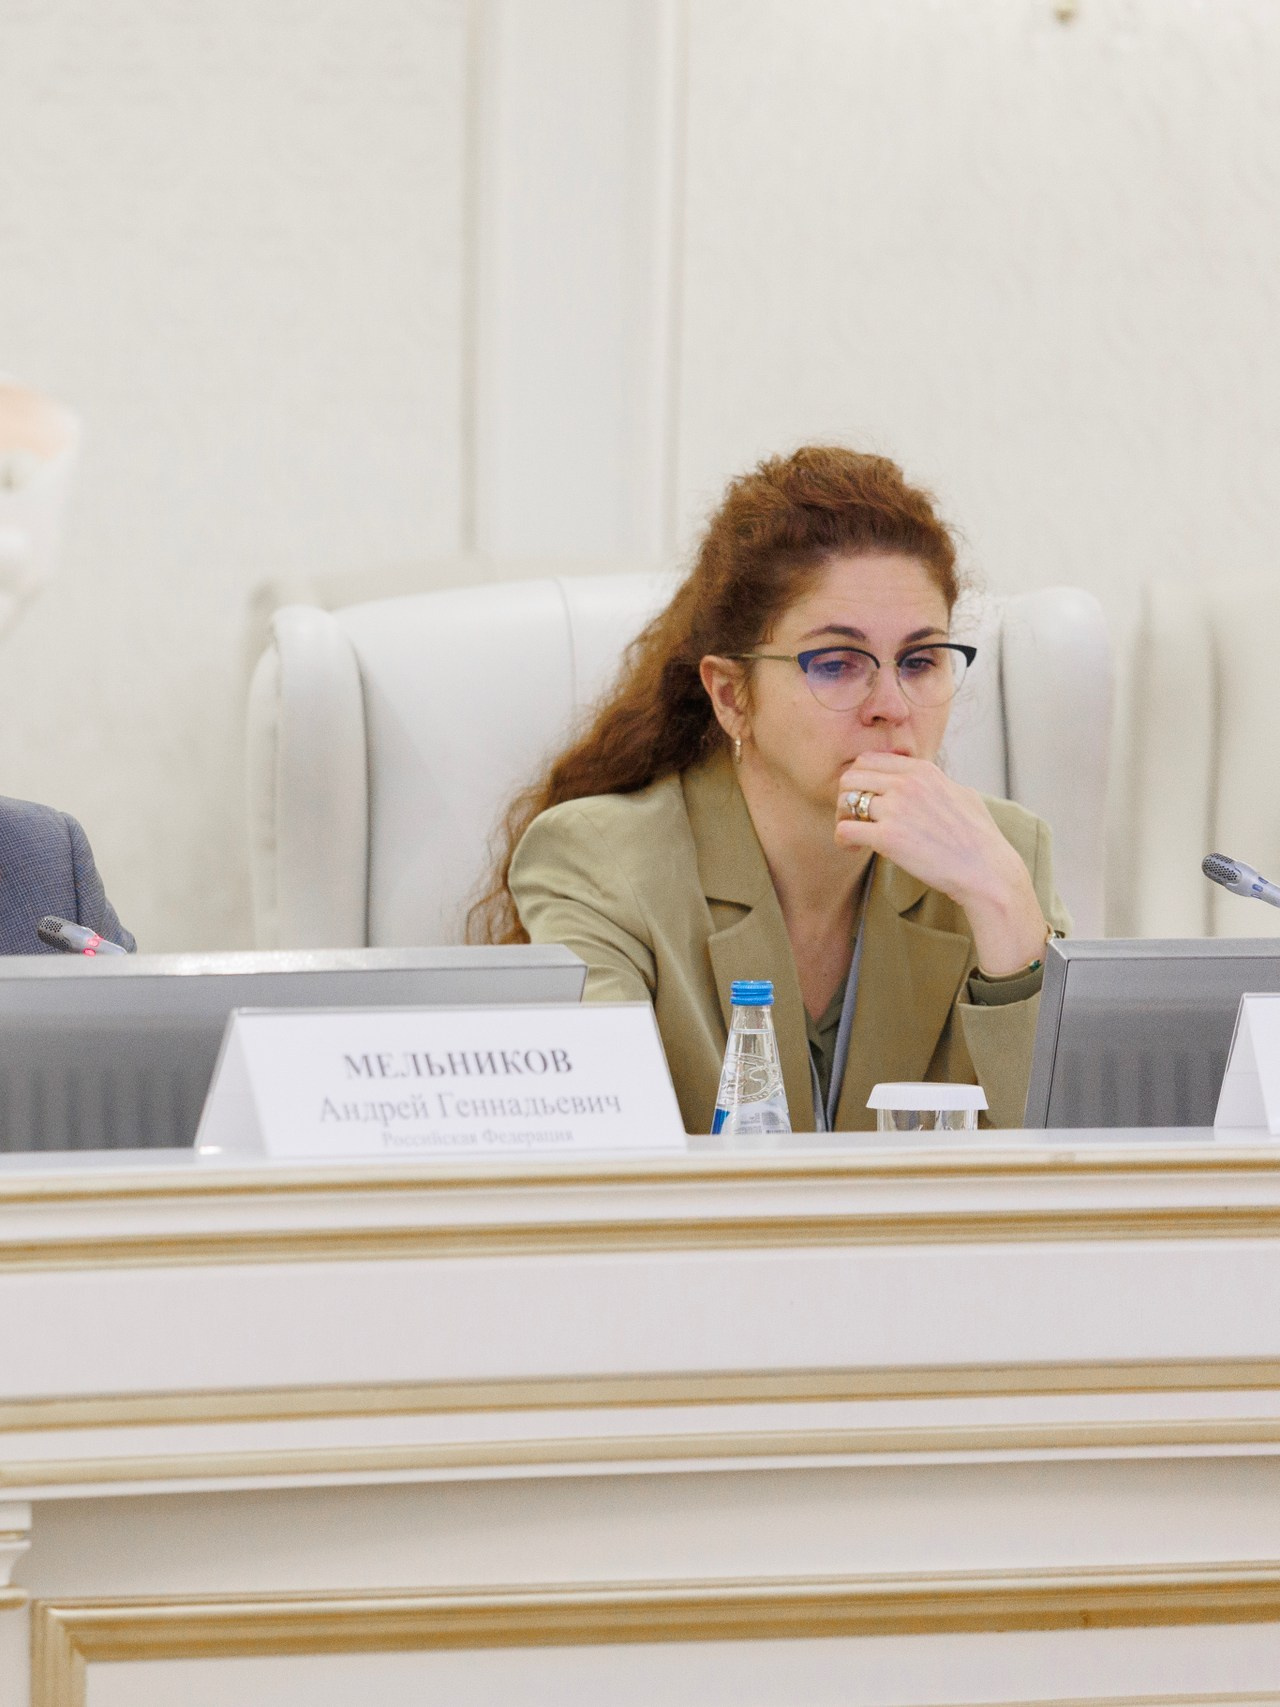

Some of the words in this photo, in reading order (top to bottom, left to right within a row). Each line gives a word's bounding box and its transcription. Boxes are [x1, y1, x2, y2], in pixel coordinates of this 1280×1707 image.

[343, 1048, 573, 1079] МЕЛЬНИКОВ
[321, 1093, 429, 1128] Андрей
[437, 1091, 623, 1119] Геннадьевич
[381, 1131, 478, 1147] Российская
[481, 1128, 574, 1147] Федерация
